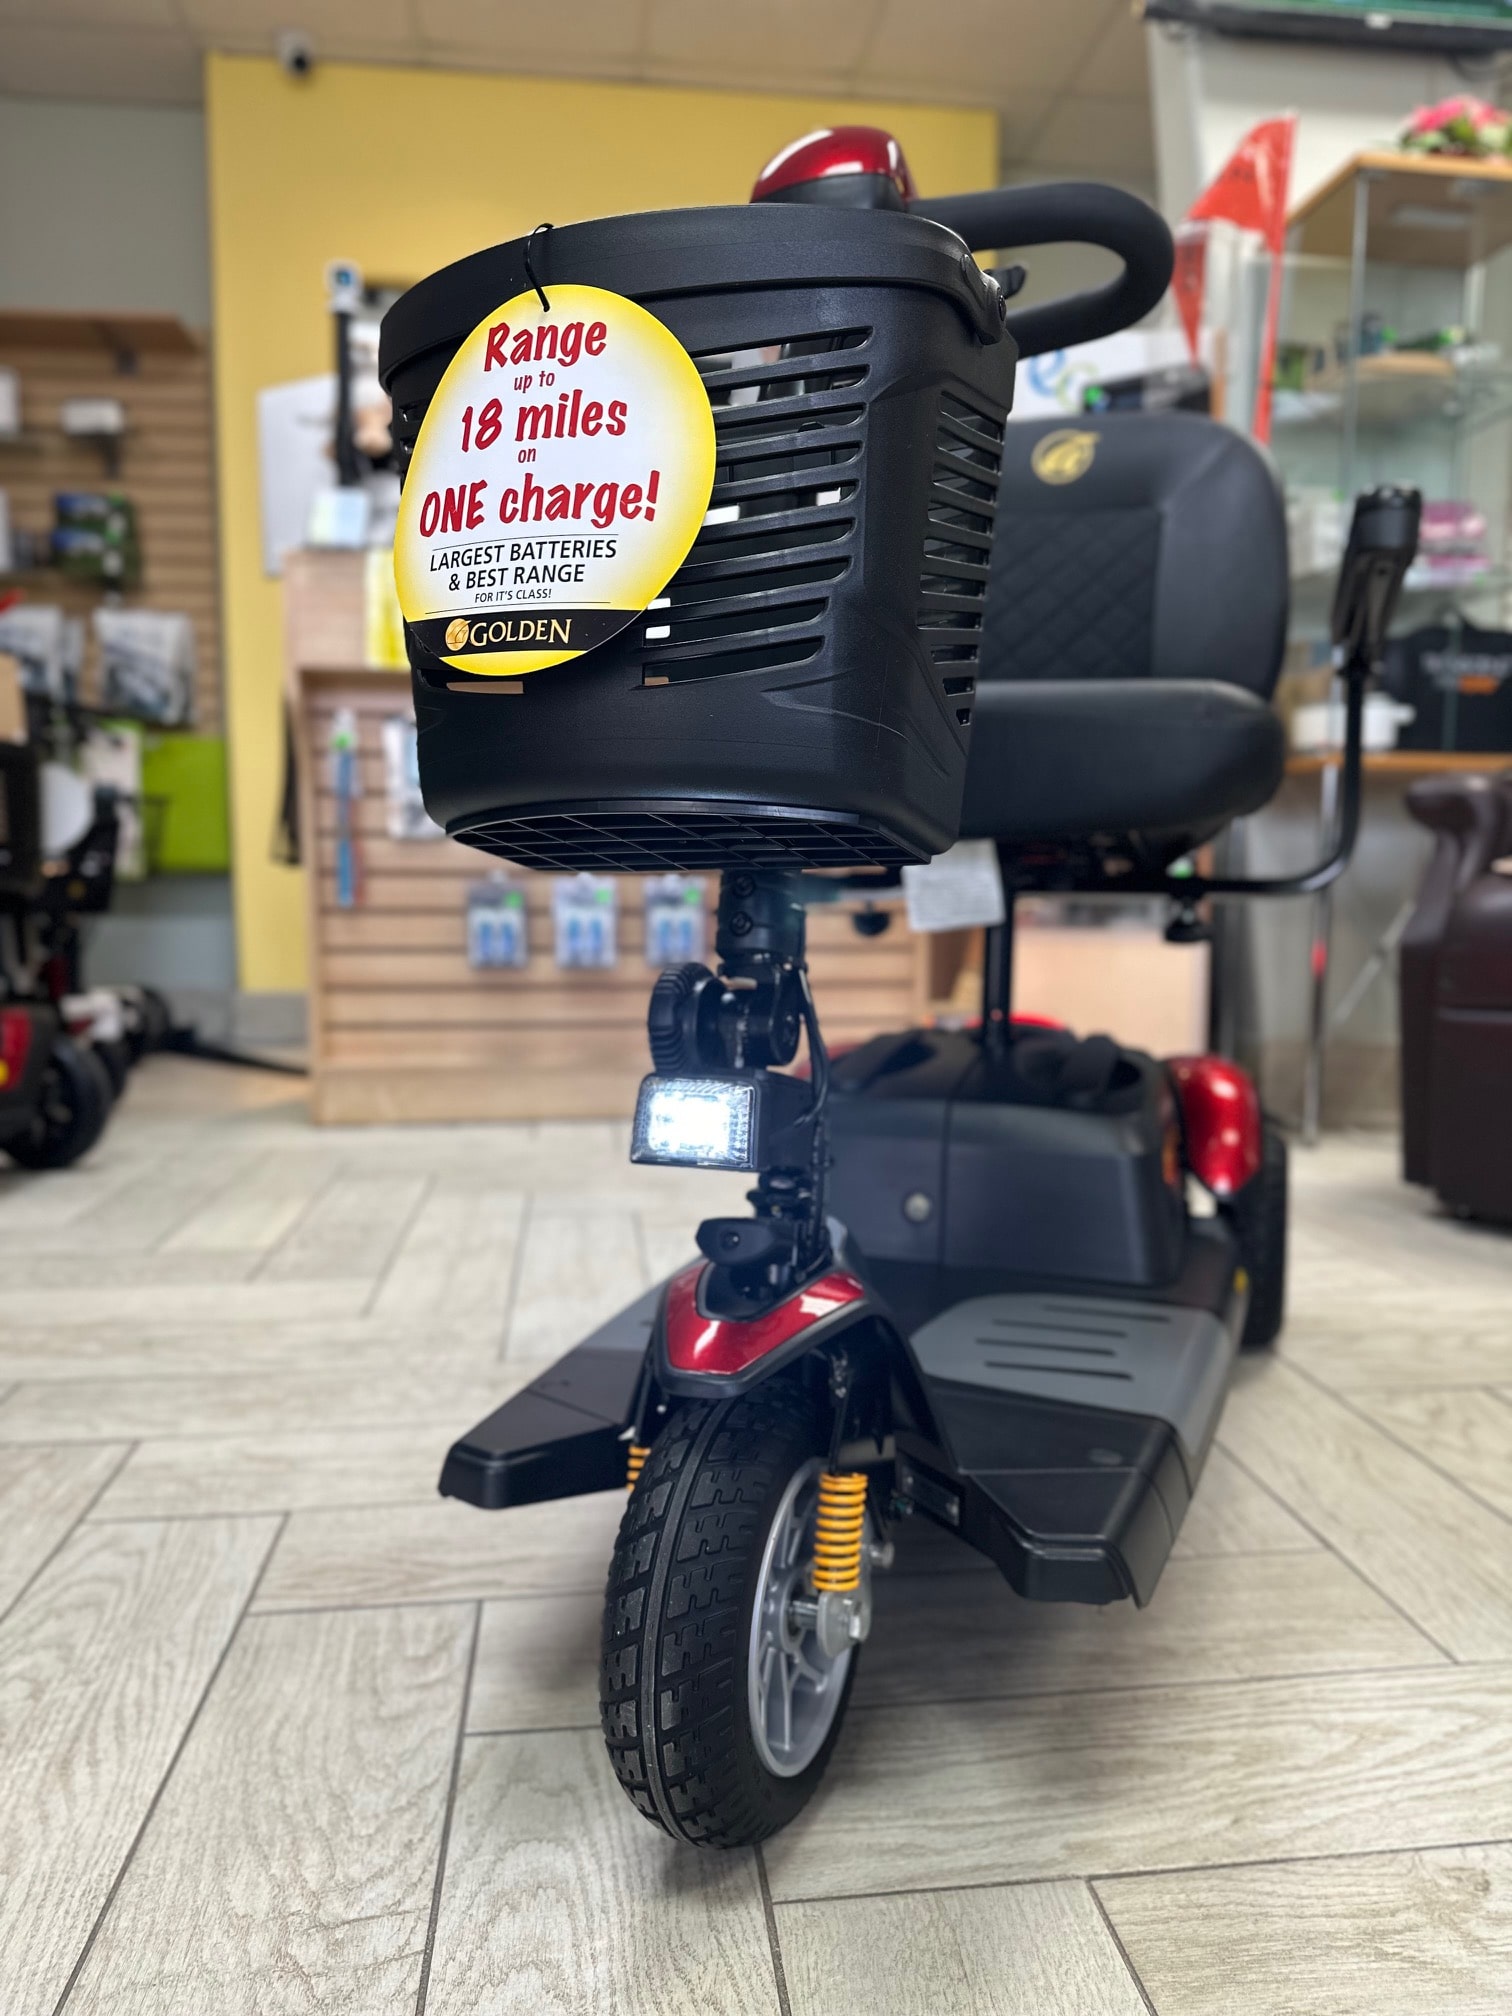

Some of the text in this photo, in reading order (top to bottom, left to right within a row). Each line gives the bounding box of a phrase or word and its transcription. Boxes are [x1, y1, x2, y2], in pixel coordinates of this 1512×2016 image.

[484, 322, 607, 371] Range
[514, 371, 555, 393] up to
[461, 389, 627, 452] 18 miles
[518, 448, 536, 463] on
[419, 470, 660, 537] ONE charge!
[430, 539, 617, 572] LARGEST BATTERIES
[448, 564, 585, 591] & BEST RANGE
[474, 589, 552, 603] FOR IT'S CLASS!
[470, 619, 572, 647] GOLDEN
